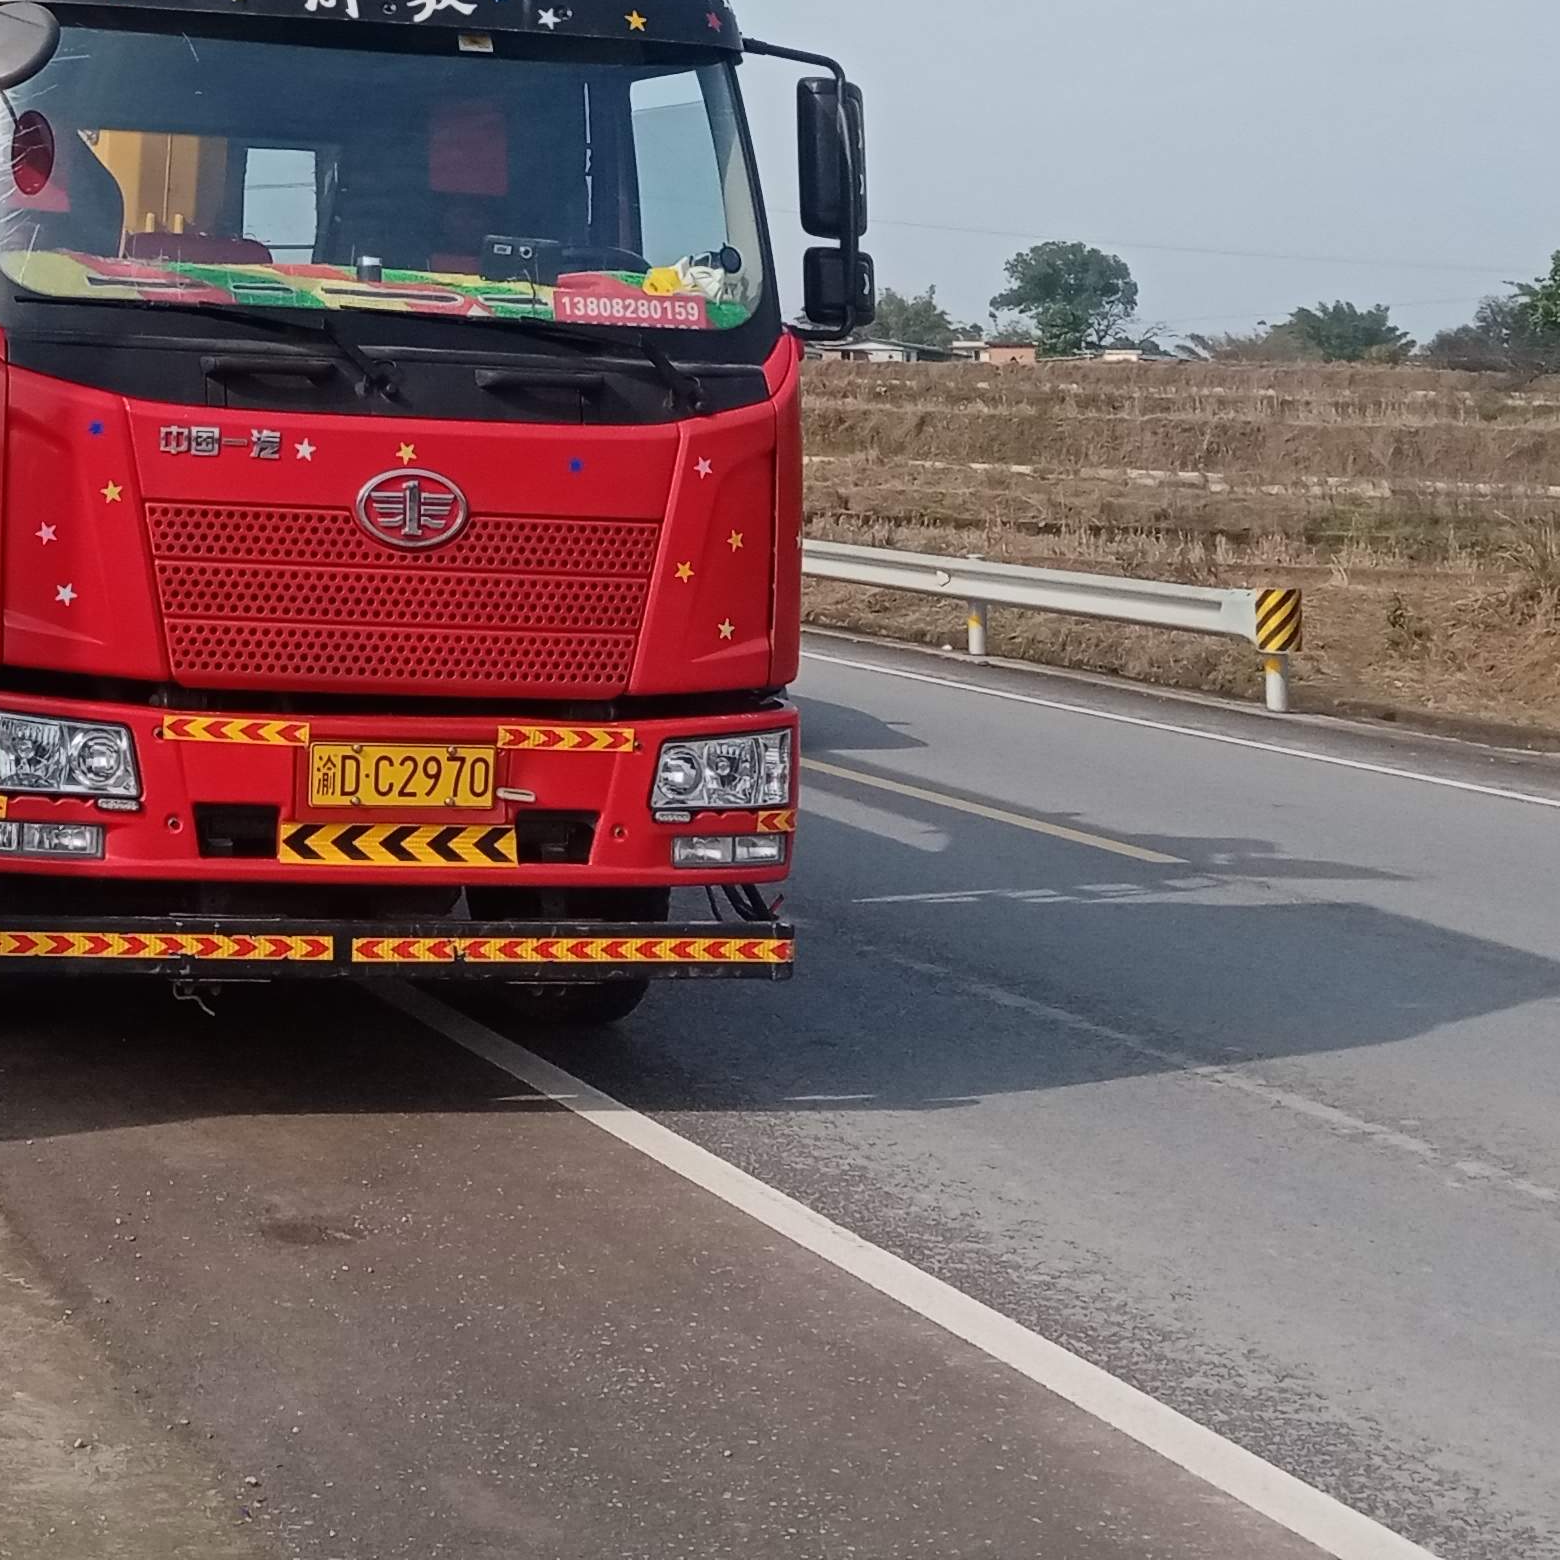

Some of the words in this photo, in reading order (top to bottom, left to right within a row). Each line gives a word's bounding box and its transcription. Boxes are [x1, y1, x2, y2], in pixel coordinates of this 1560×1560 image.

[561, 296, 699, 321] 13808280159
[160, 425, 280, 459] 中国一汽
